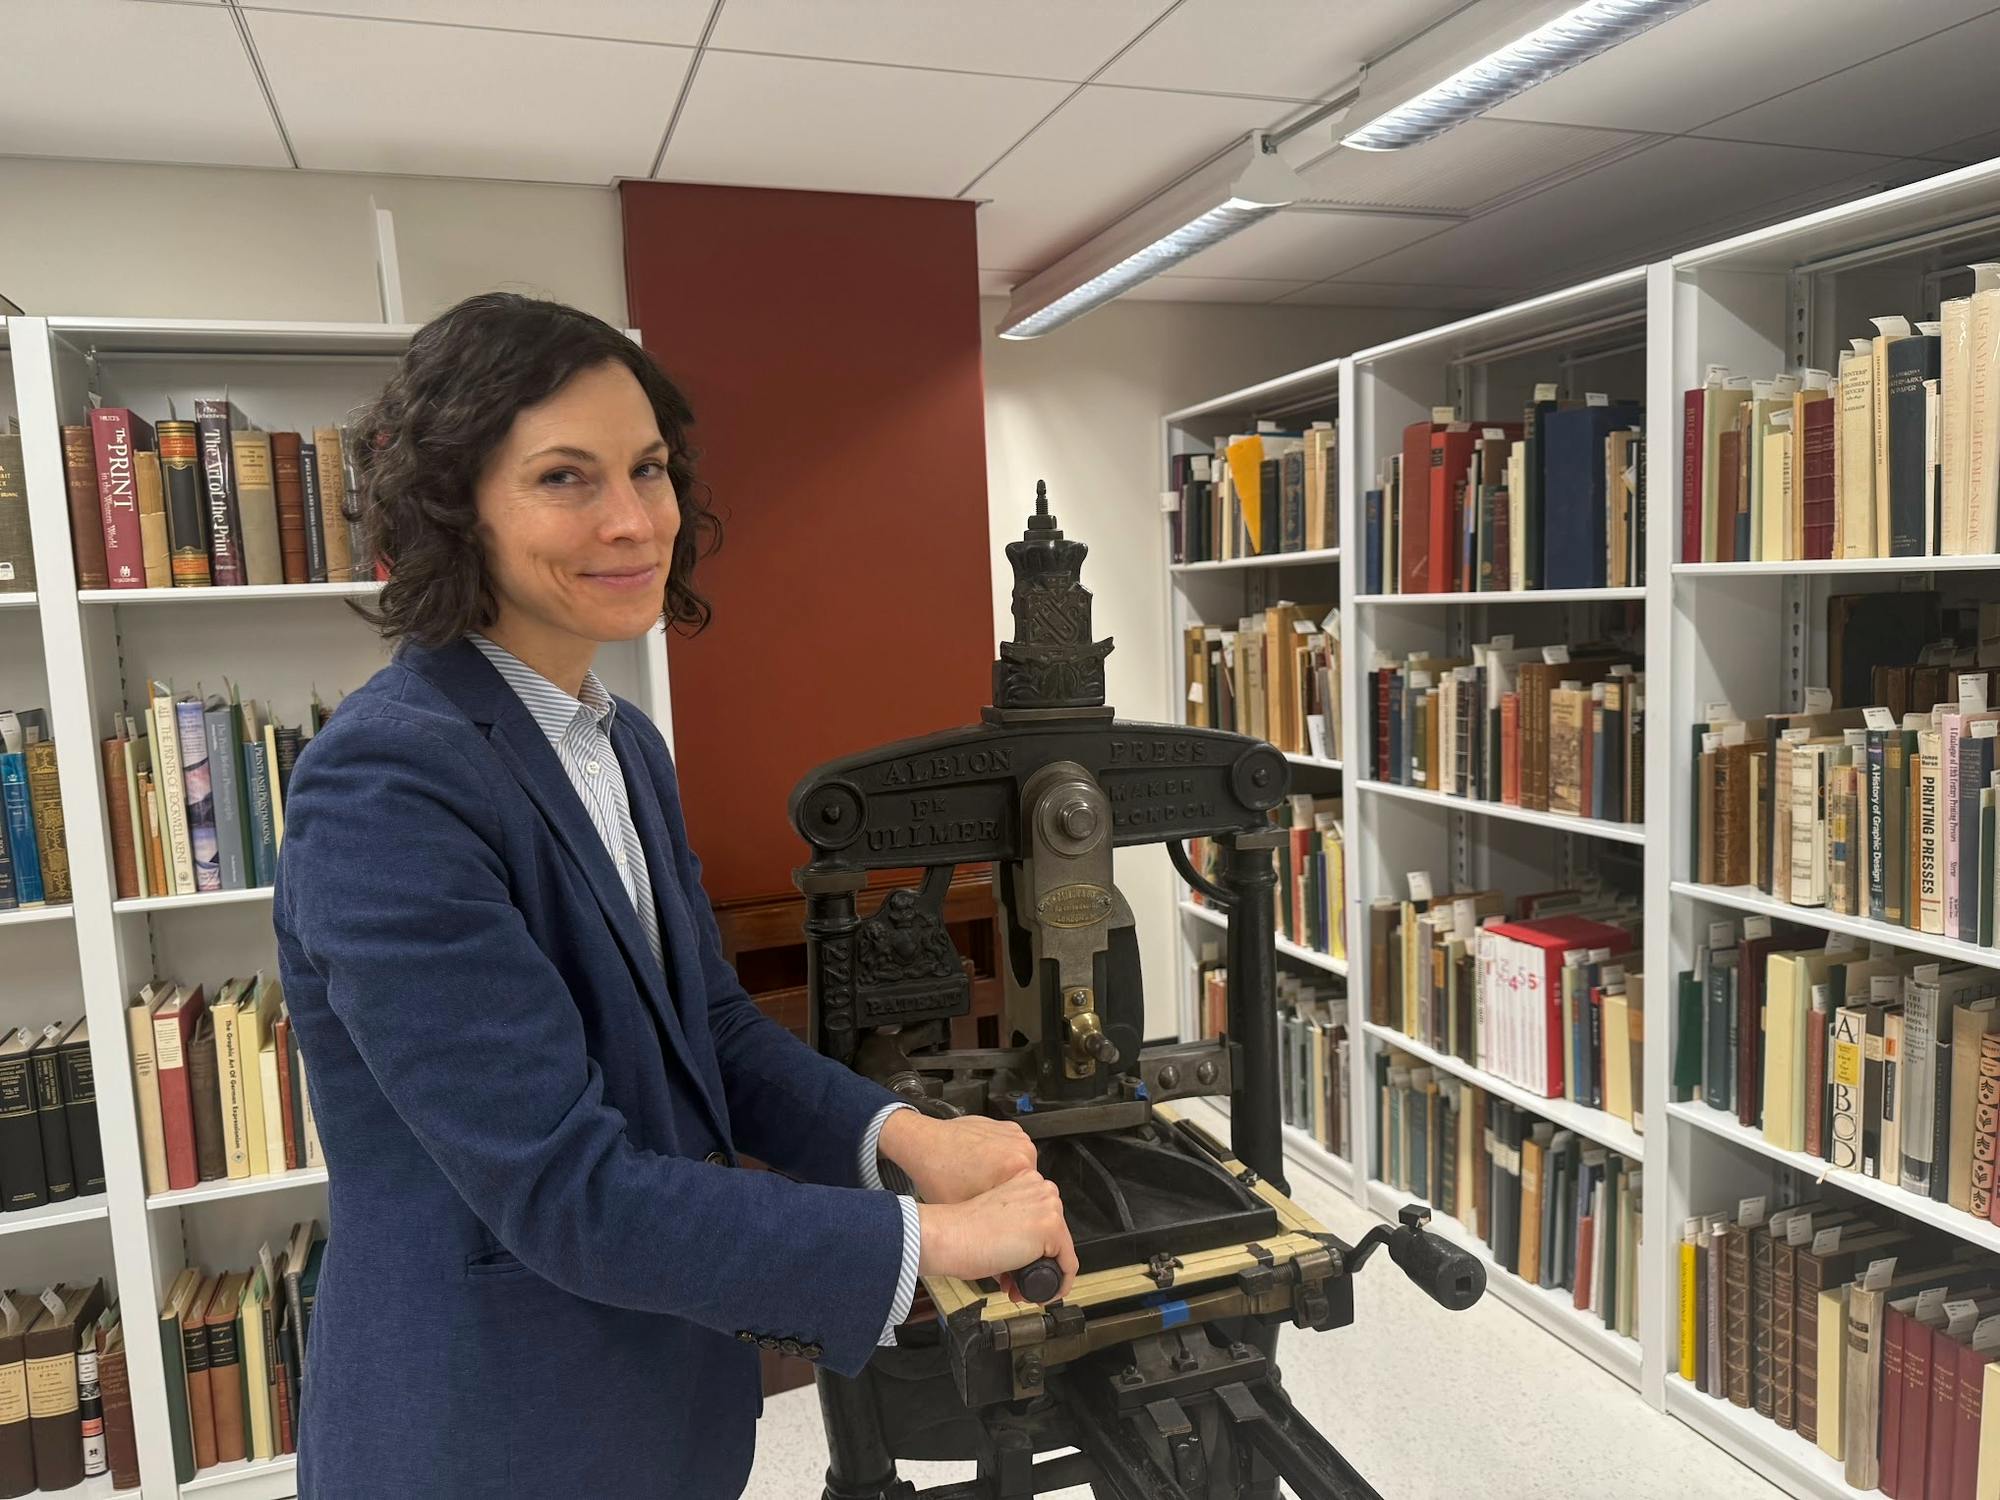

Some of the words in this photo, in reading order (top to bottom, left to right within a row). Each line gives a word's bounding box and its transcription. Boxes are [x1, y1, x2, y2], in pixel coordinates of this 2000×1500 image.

[115, 428, 126, 444] The
[204, 428, 222, 458] The
[107, 444, 134, 512] PRINT
[205, 459, 224, 482] Art
[209, 482, 225, 499] of
[103, 494, 114, 524] Western
[211, 500, 227, 523] the
[324, 493, 336, 528] PRINTS
[107, 525, 118, 549] World
[213, 523, 229, 556] Print
[161, 726, 173, 743] THE
[163, 744, 176, 775] PRINTS
[882, 749, 1013, 786] ALBION
[1110, 740, 1208, 764] PRESS
[1871, 763, 1880, 771] A
[1109, 779, 1194, 802] MAKER
[1869, 772, 1881, 804] History
[1112, 803, 1216, 826] LONDON
[1872, 805, 1881, 815] of
[1922, 776, 1935, 834] PRINTING
[865, 820, 1000, 851] ULLMER
[1871, 815, 1882, 851] Graphic
[174, 840, 187, 864] KENT
[1921, 838, 1934, 895] PRESSES
[1871, 852, 1882, 882] Design
[1837, 1016, 1855, 1044] A
[226, 1032, 236, 1058] Graphic
[229, 1058, 237, 1069] Art
[1836, 1083, 1851, 1112] B
[231, 1106, 241, 1149] Expressionism
[1832, 1138, 1856, 1168] D
